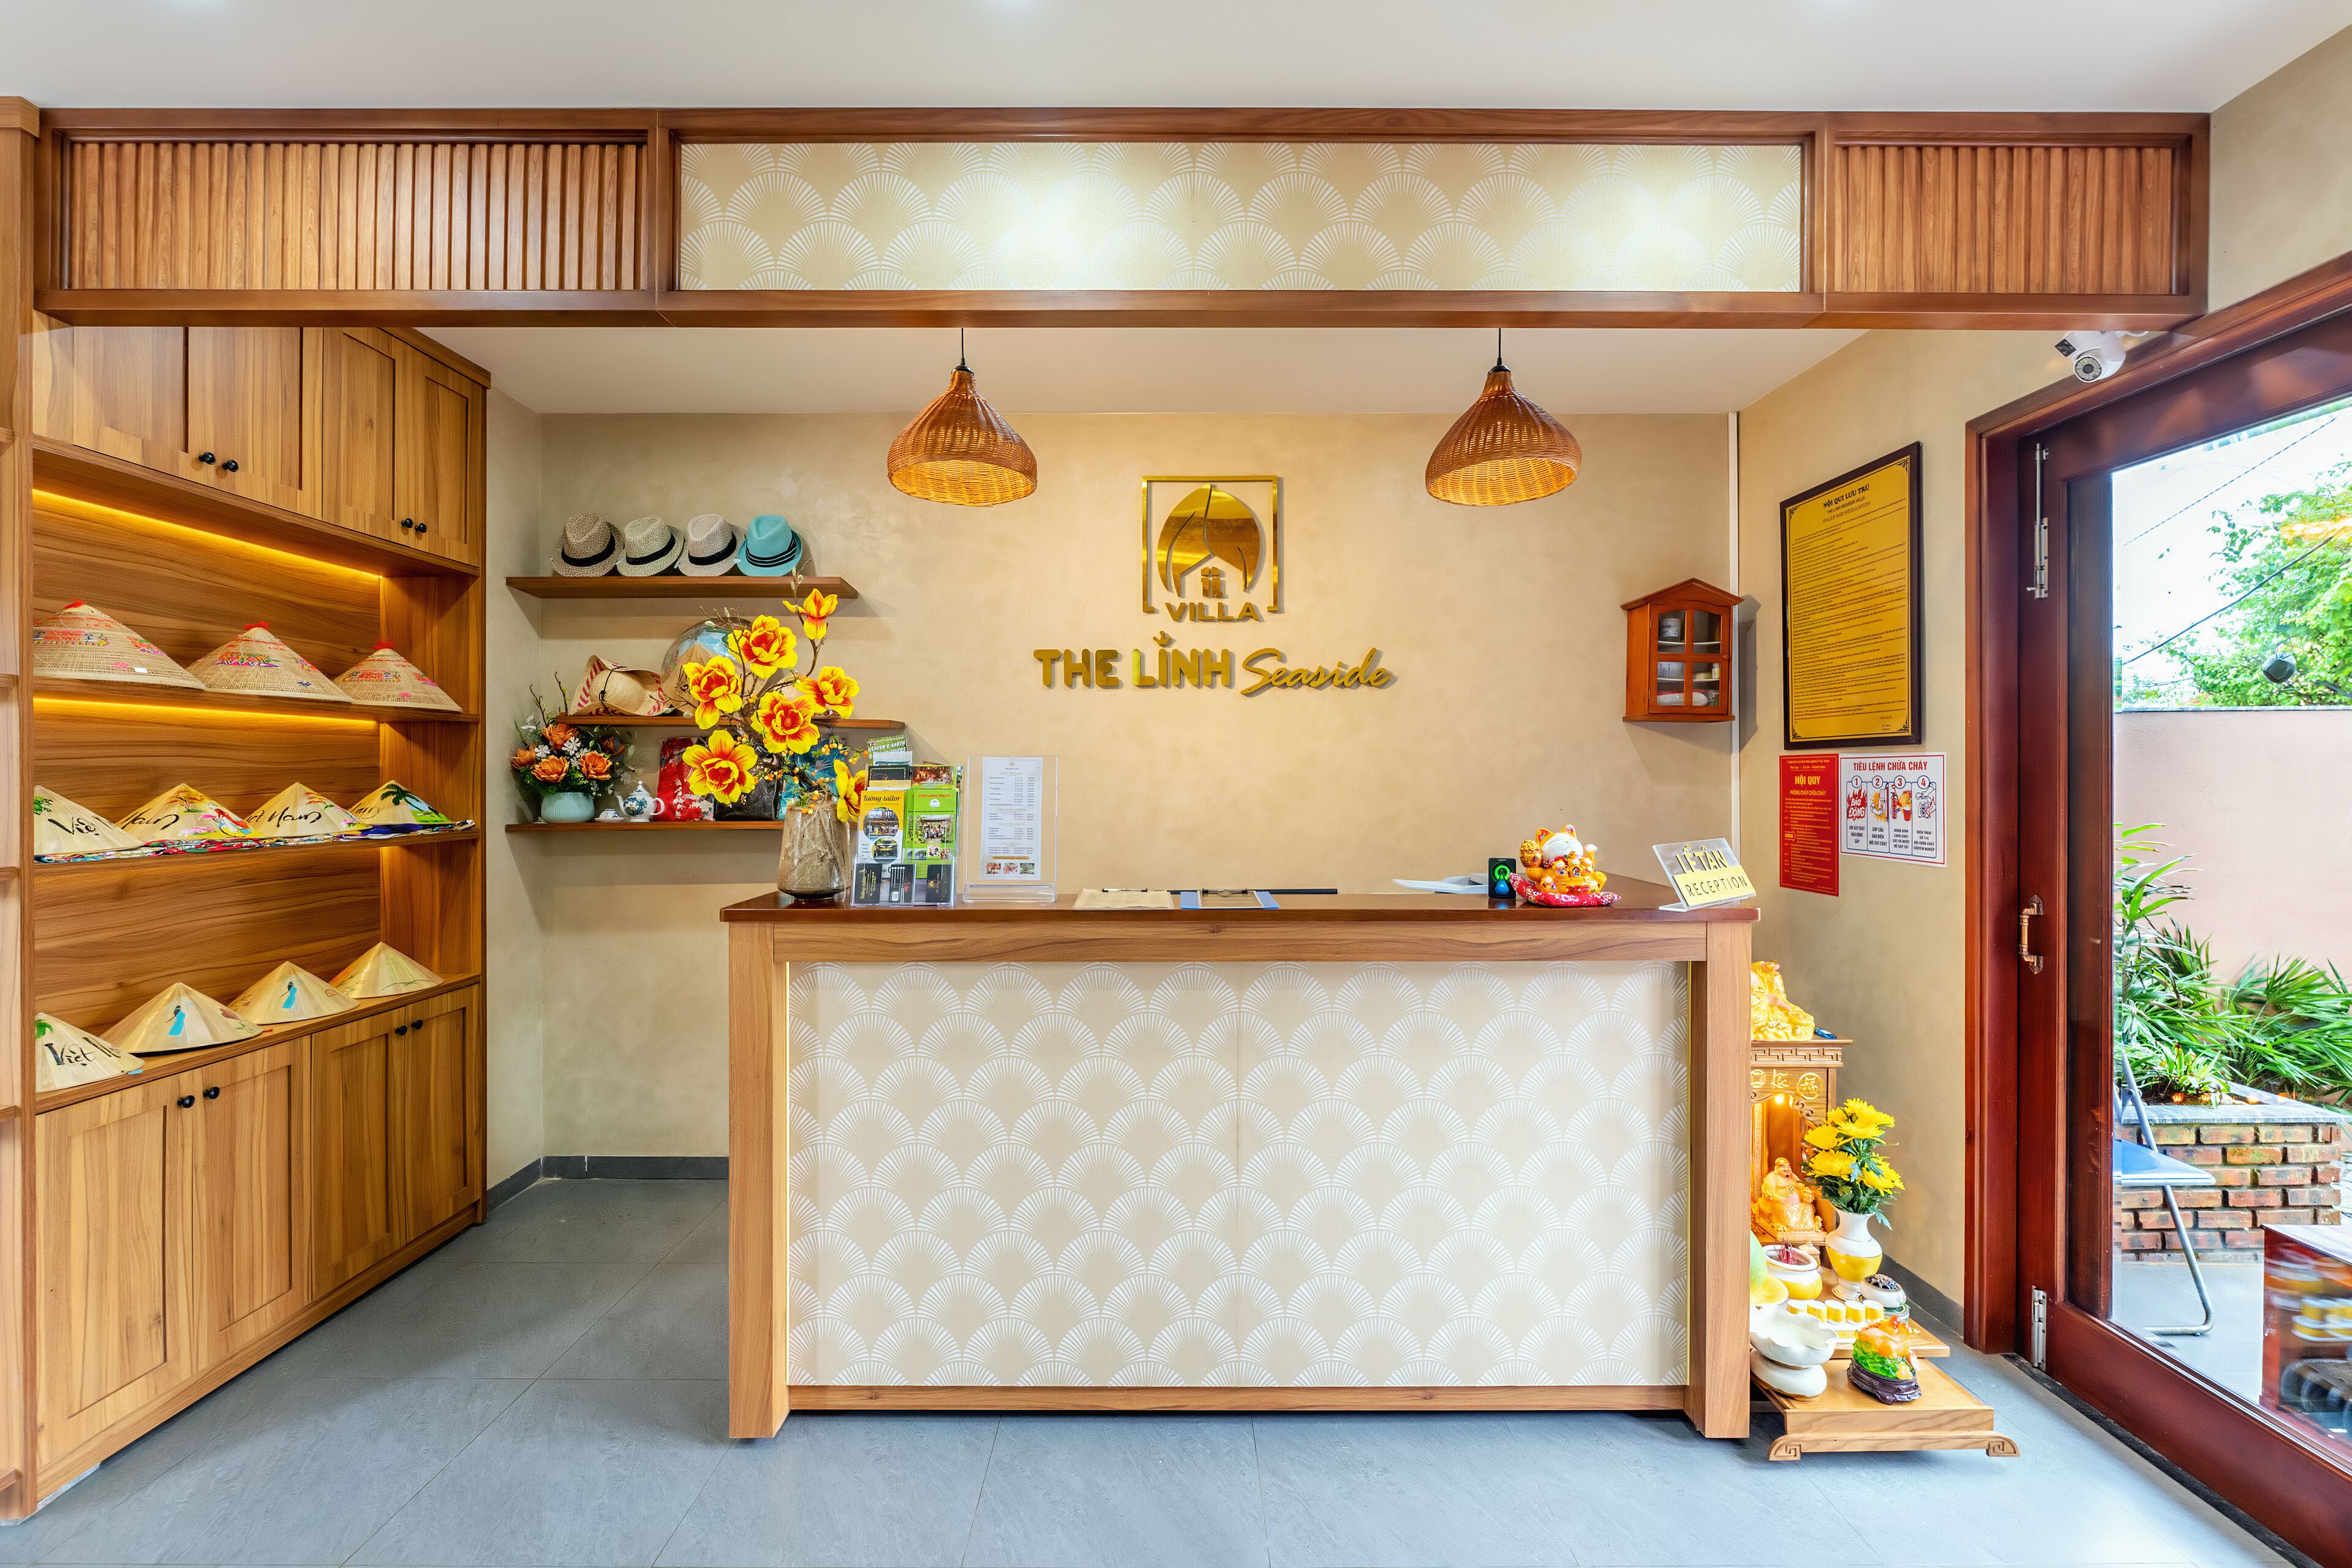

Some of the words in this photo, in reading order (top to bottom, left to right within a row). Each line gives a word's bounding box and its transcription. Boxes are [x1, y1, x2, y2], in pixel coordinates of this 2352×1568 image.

[1823, 500, 1833, 508] NỘI
[1834, 496, 1844, 505] QUI
[1845, 500, 1871, 514] REGULATION
[1165, 602, 1261, 621] VILLA
[1033, 649, 1120, 687] THE
[1240, 647, 1393, 696] Seaside
[1853, 761, 1866, 771] TIÊU
[1869, 761, 1885, 772] LỆNH
[1888, 760, 1906, 771] CHỮA
[1909, 760, 1928, 771] CHÁY
[1795, 774, 1806, 786] NỘI
[1807, 776, 1820, 786] QUY
[1851, 797, 1861, 807] BÁO
[1849, 806, 1865, 820] ĐỘNG
[1685, 875, 1748, 897] RECEPTION
[44, 1042, 97, 1066] Việt
